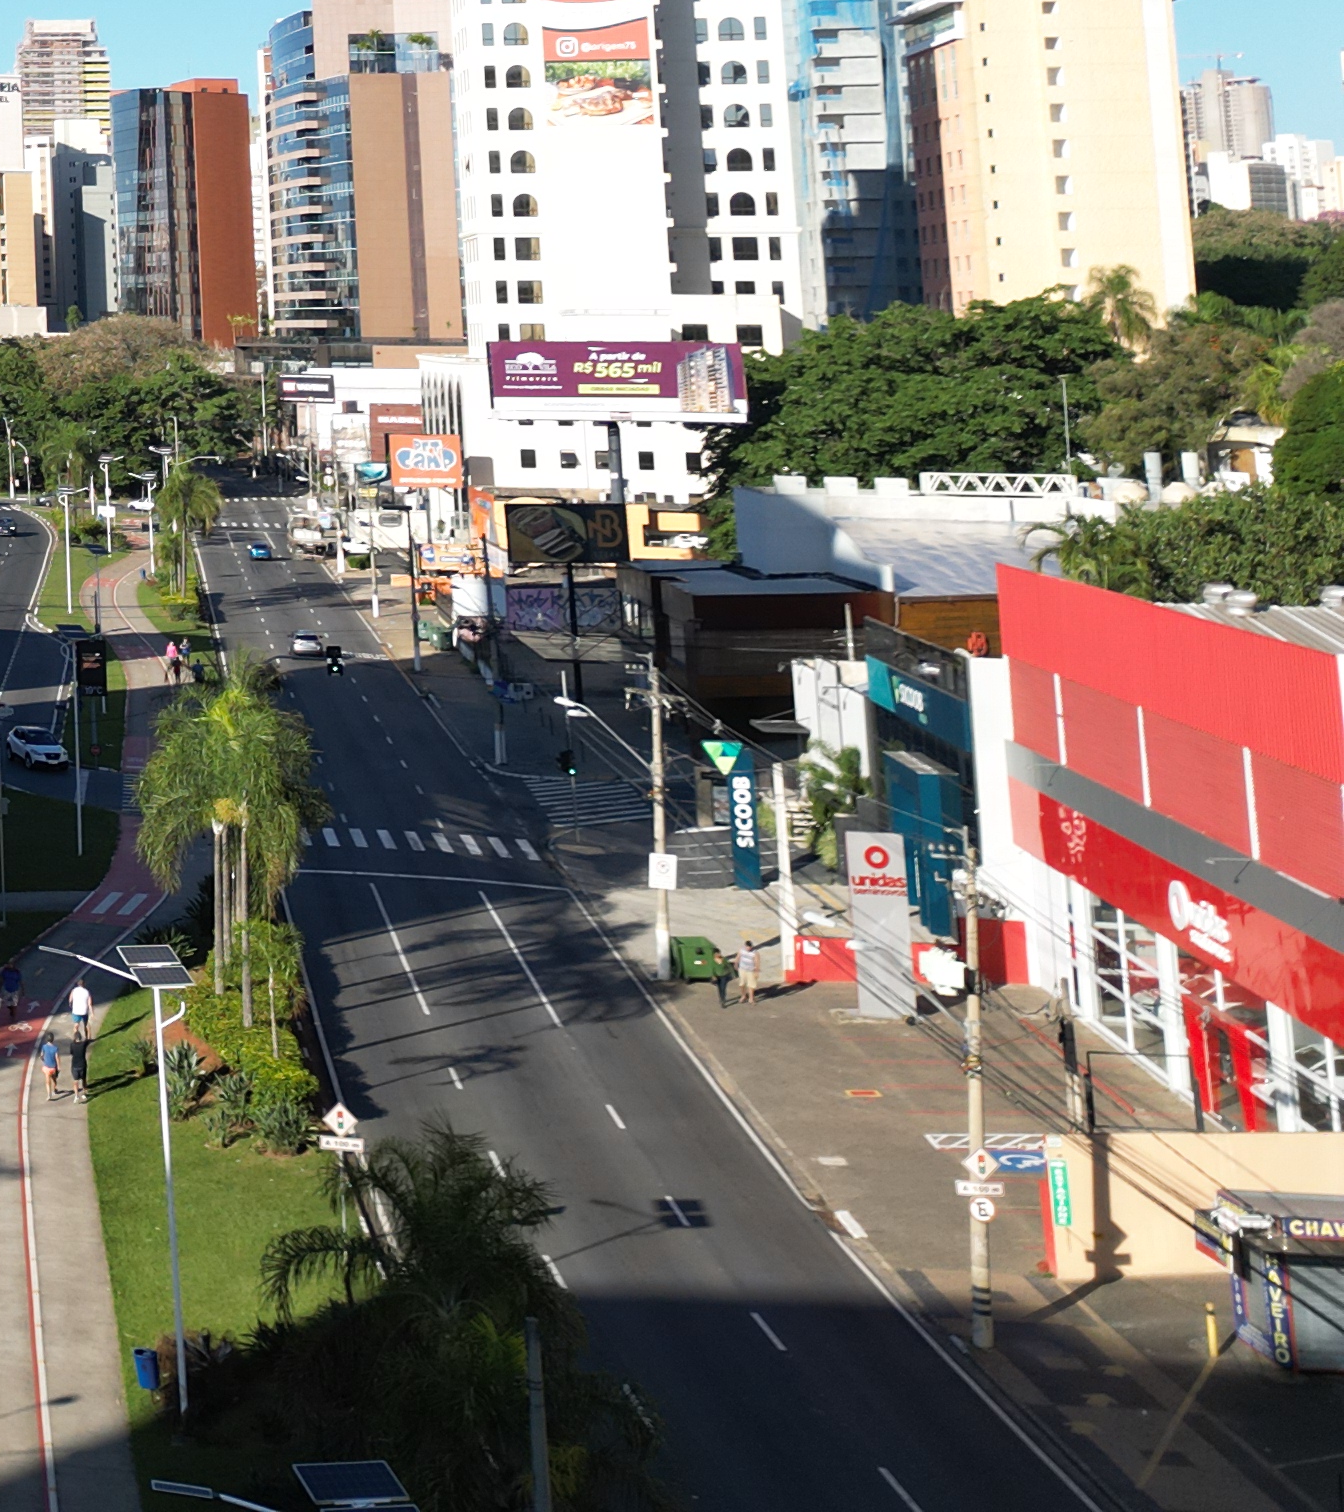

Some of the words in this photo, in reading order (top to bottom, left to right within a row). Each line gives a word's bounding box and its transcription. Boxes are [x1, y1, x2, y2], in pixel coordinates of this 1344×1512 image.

[588, 352, 599, 360] A
[599, 351, 632, 362] partir
[632, 352, 646, 361] de
[573, 362, 594, 374] R$
[594, 362, 636, 378] 565
[637, 361, 662, 374] mil
[731, 775, 755, 849] SICOOB
[851, 872, 908, 888] unidas
